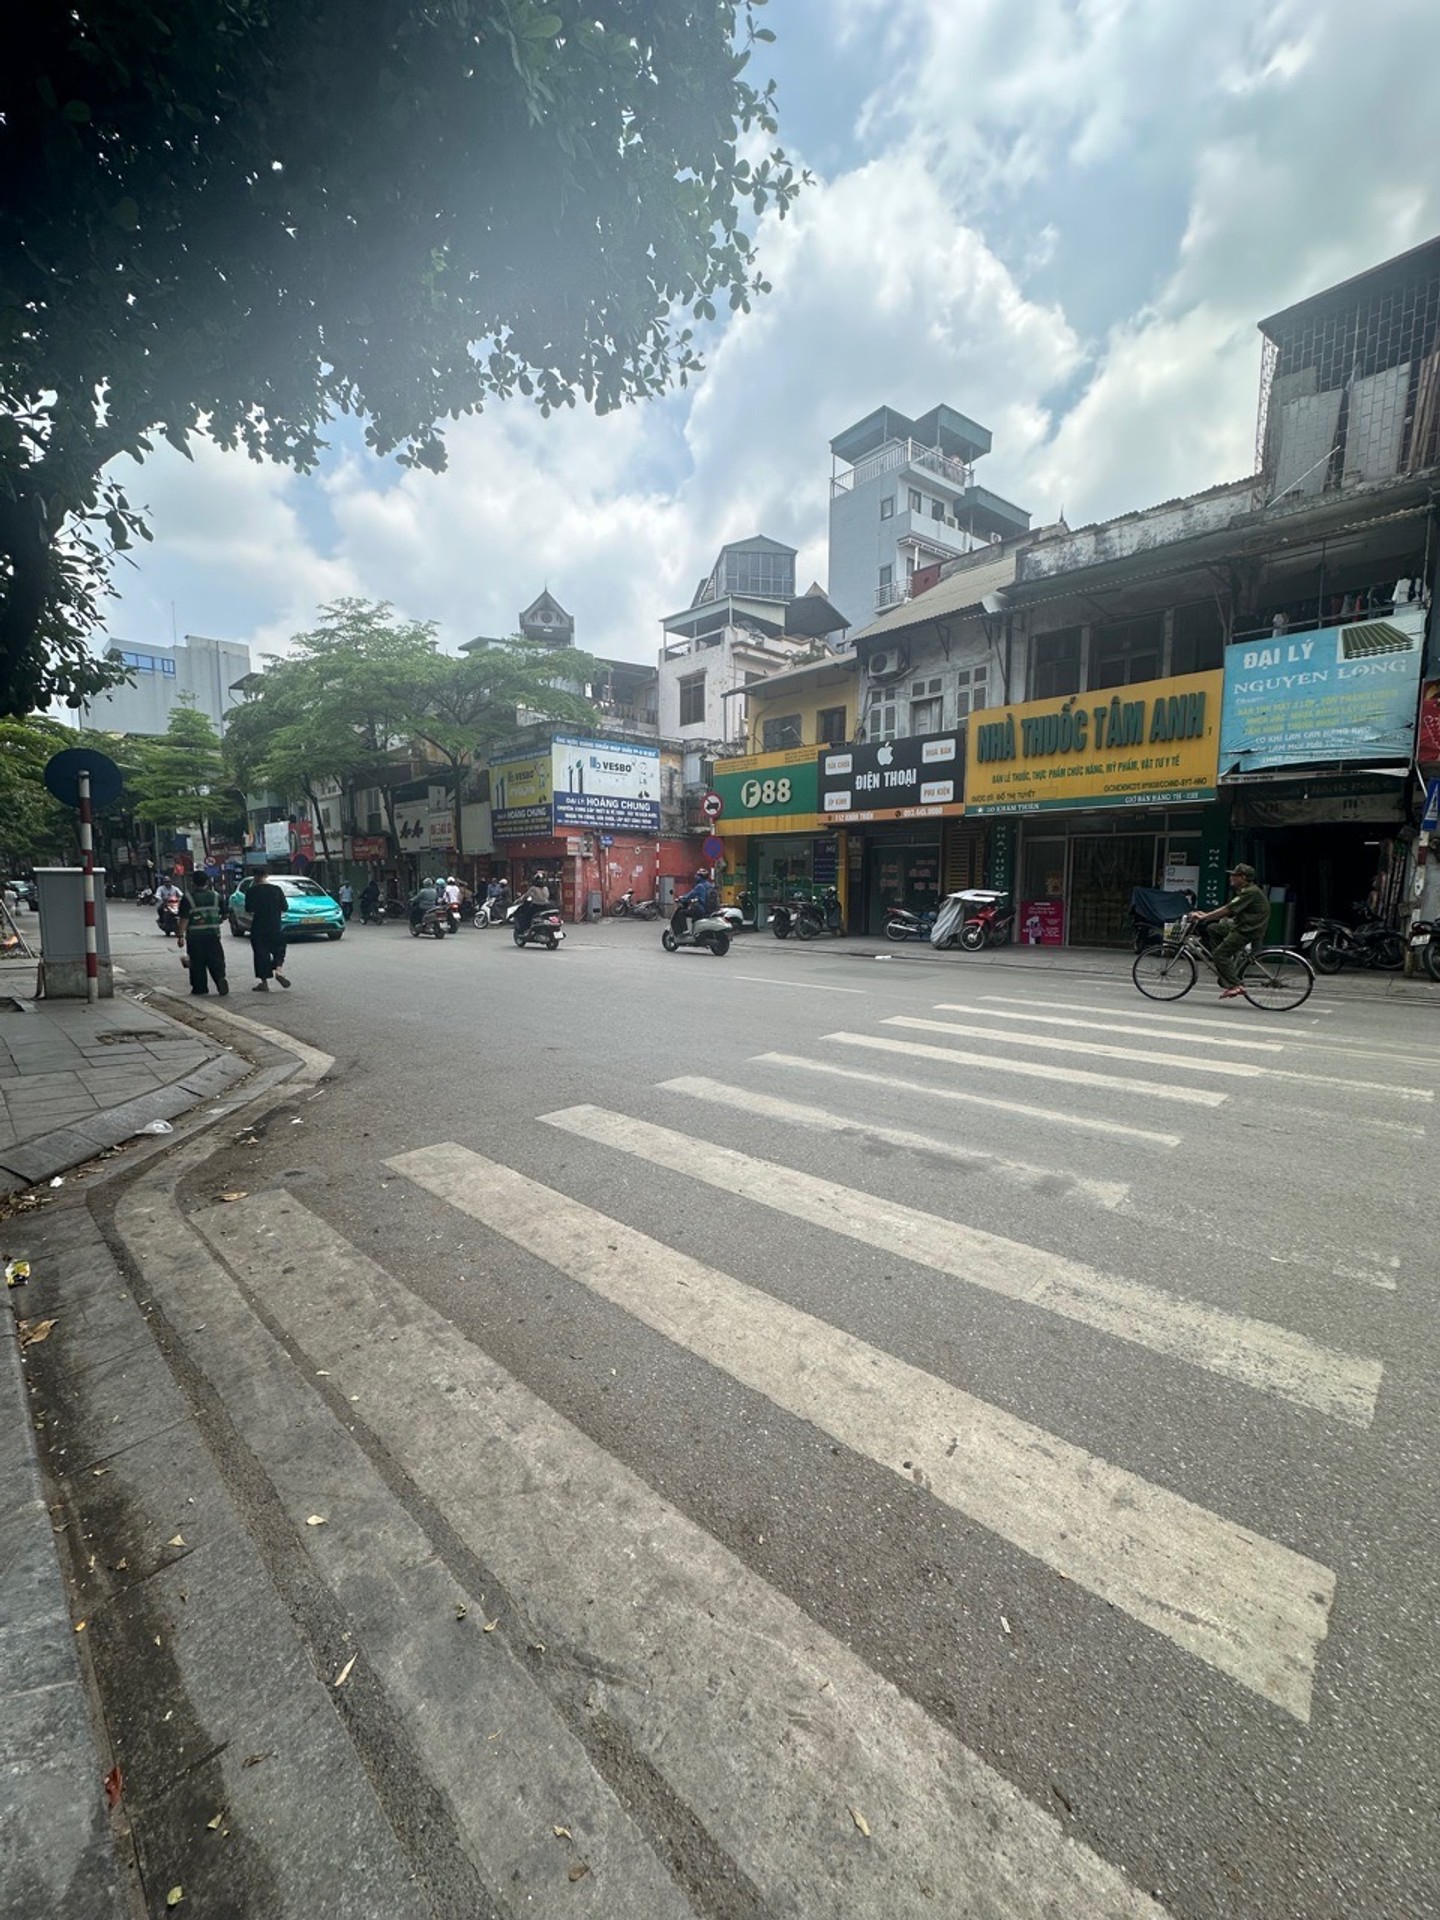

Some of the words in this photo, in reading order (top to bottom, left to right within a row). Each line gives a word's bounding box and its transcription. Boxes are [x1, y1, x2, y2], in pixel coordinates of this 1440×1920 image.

[1244, 648, 1281, 670] ĐẠI
[1288, 638, 1316, 662] LÝ
[1337, 659, 1408, 680] LONG
[977, 713, 1016, 763] NHÀ
[1021, 696, 1089, 758] THUỐC
[1094, 696, 1146, 750] TÂM
[1150, 692, 1206, 743] ANH
[602, 761, 632, 773] VESBO
[855, 770, 880, 792] ĐIỆN
[884, 768, 917, 788] THOẠI
[992, 773, 1003, 784] BÁN
[586, 796, 619, 809] HOÀNG
[620, 800, 651, 812] CHUNG
[741, 778, 791, 808] F88
